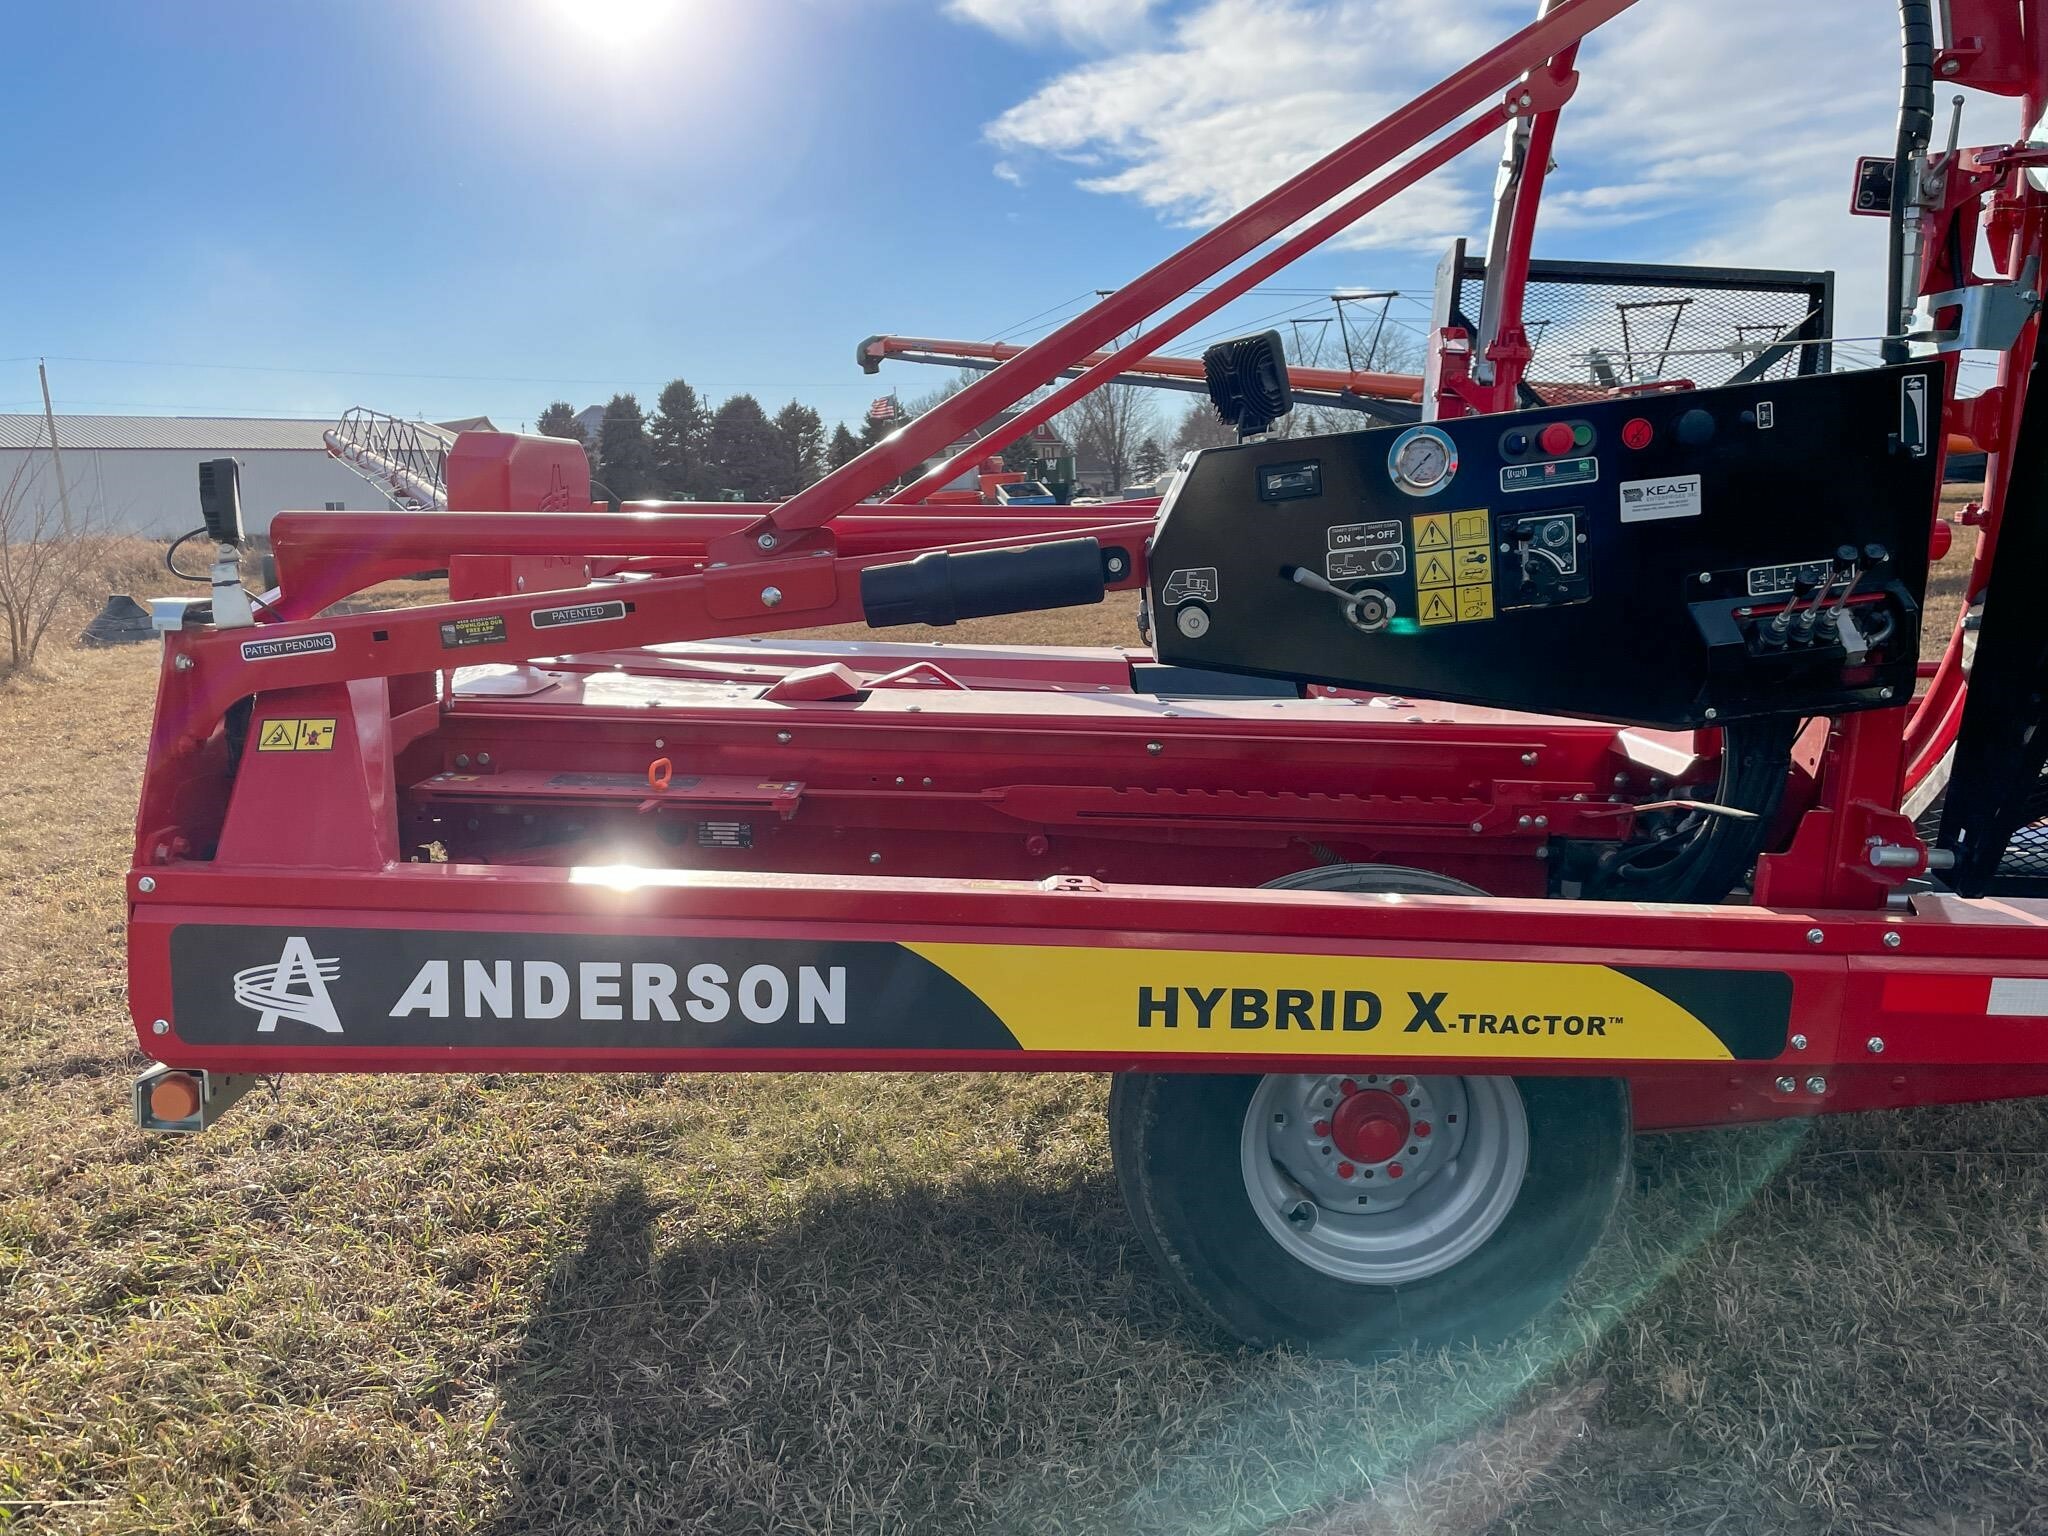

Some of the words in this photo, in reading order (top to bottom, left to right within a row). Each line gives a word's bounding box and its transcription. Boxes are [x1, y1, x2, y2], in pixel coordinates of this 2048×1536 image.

[1646, 482, 1698, 496] KEAST
[1336, 534, 1351, 543] ON
[1376, 530, 1396, 539] OFF
[551, 606, 604, 620] PATENTED
[455, 621, 490, 630] DOWNLOAD
[490, 619, 503, 627] OUR
[244, 644, 283, 656] PATENT
[285, 638, 332, 651] PENDING
[388, 959, 847, 1025] ANDERSON
[1138, 986, 1383, 1032] HYBRID
